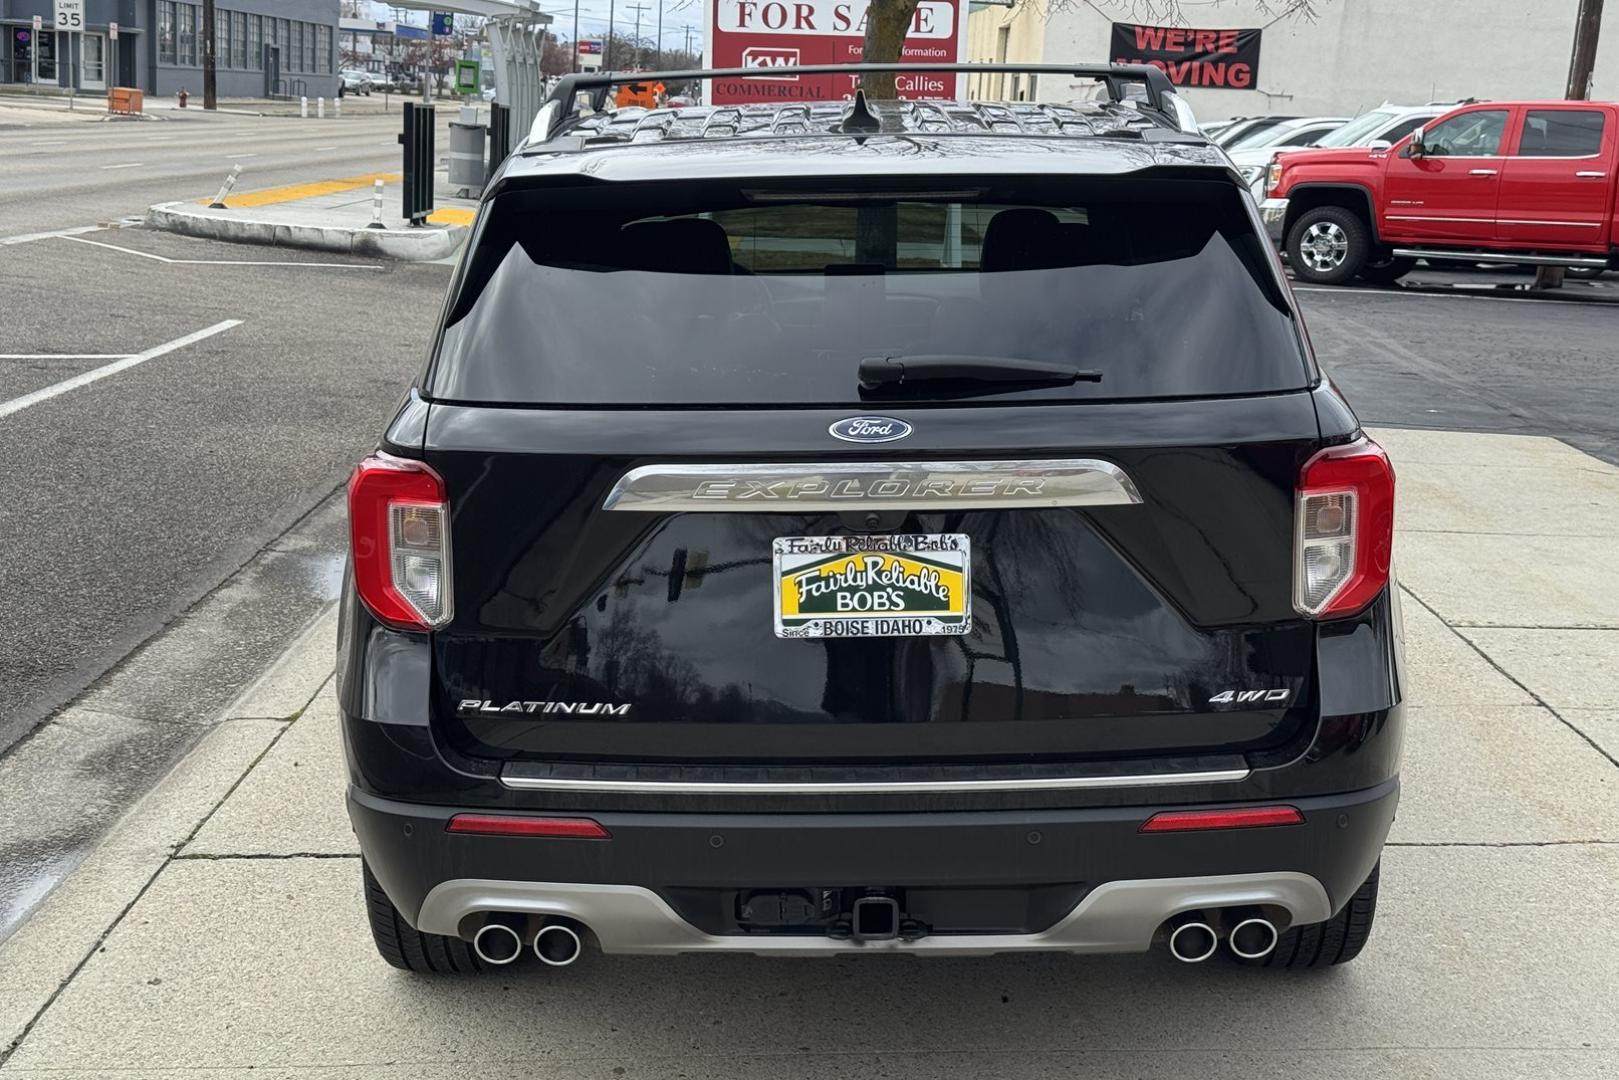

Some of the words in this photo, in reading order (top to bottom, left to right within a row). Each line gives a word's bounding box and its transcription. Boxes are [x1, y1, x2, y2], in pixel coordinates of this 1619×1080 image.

[58, 12, 81, 26] 35
[736, 1, 817, 30] FOR
[833, 4, 935, 34] SAE
[1135, 26, 1240, 54] WE'RE
[715, 82, 825, 99] COMMERCIAL
[894, 76, 945, 92] Callies
[848, 420, 893, 435] Ford
[692, 478, 1048, 499] EXPLORER
[785, 537, 842, 554] Fairly
[794, 561, 868, 603] Fairly
[864, 555, 950, 601] Reliable
[836, 587, 905, 611] BOB'S
[782, 628, 810, 638] Since
[823, 620, 869, 636] BOISE
[874, 619, 924, 635] IDAHO
[1208, 688, 1290, 703] 4WD
[457, 699, 632, 716] PLATINUM
